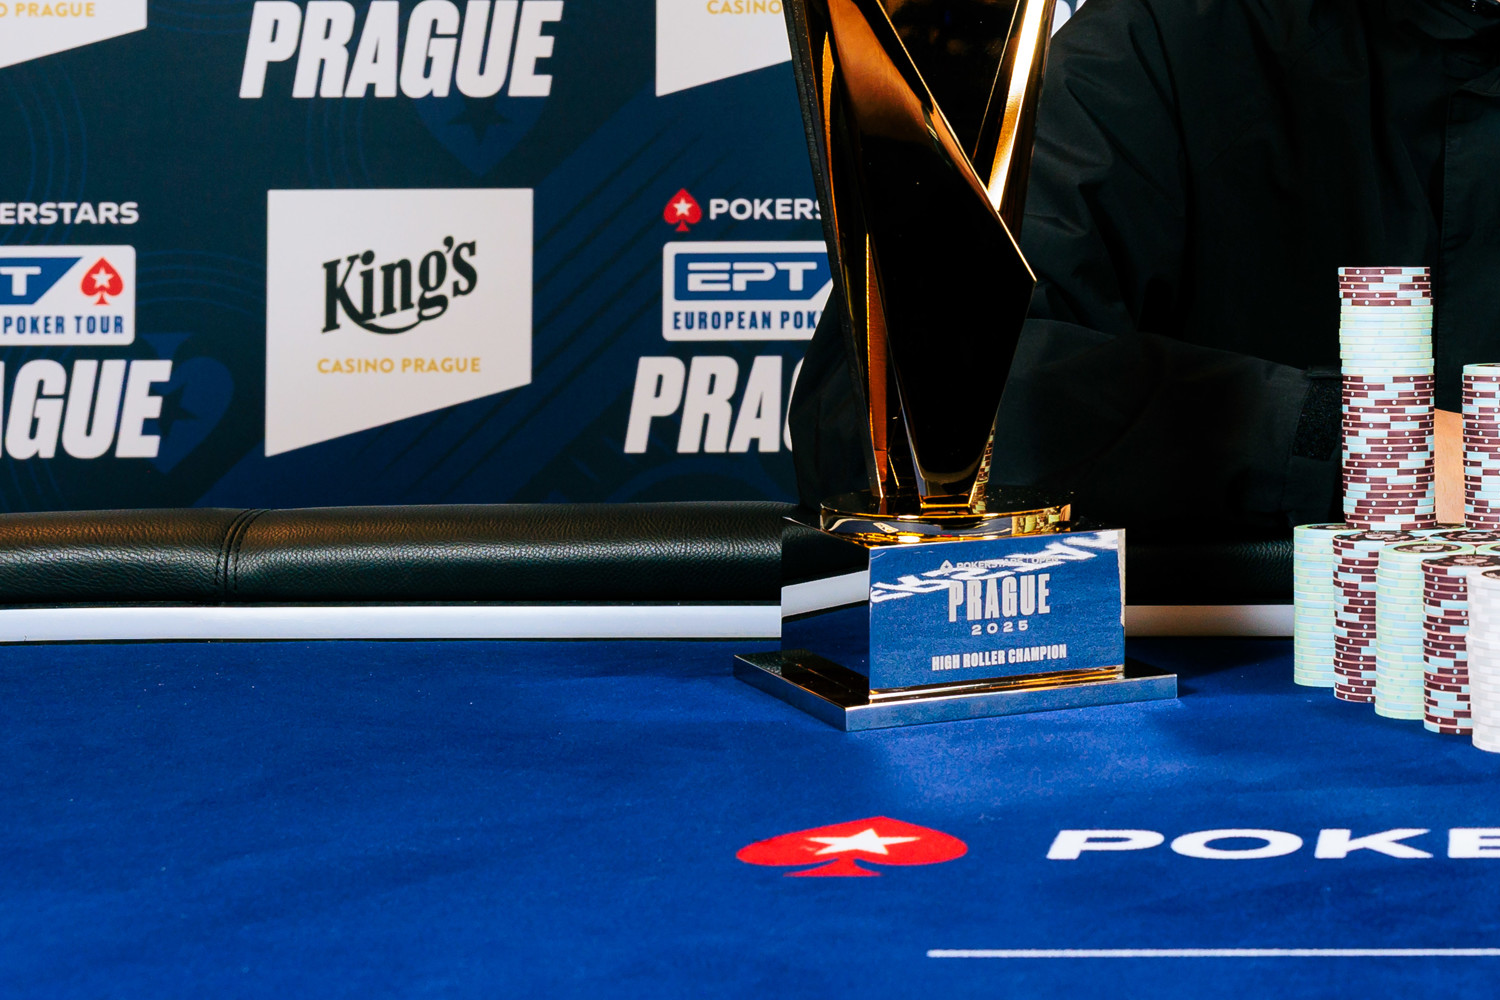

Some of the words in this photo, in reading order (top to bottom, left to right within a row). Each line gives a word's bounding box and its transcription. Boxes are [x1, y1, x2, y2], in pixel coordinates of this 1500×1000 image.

[15, 2, 95, 17] PRAGUE
[706, 0, 783, 15] CASINO
[240, 0, 563, 98] PRAGUE
[709, 199, 821, 220] POKER
[322, 236, 477, 334] King's
[687, 262, 817, 292] EPT
[3, 315, 65, 335] POKER
[74, 315, 124, 335] TOUR
[673, 311, 771, 330] EUROPEAN
[780, 310, 823, 330] POK
[317, 358, 395, 374] CASINO
[401, 357, 480, 373] PRAGUE
[0, 359, 173, 460] GUE
[624, 355, 804, 453] PRA
[948, 573, 1051, 622] PRAGUE
[971, 620, 1029, 636] 2025
[931, 655, 960, 671] HIGH
[962, 650, 1006, 668] ROLLER
[1007, 643, 1067, 664] CHAMPION
